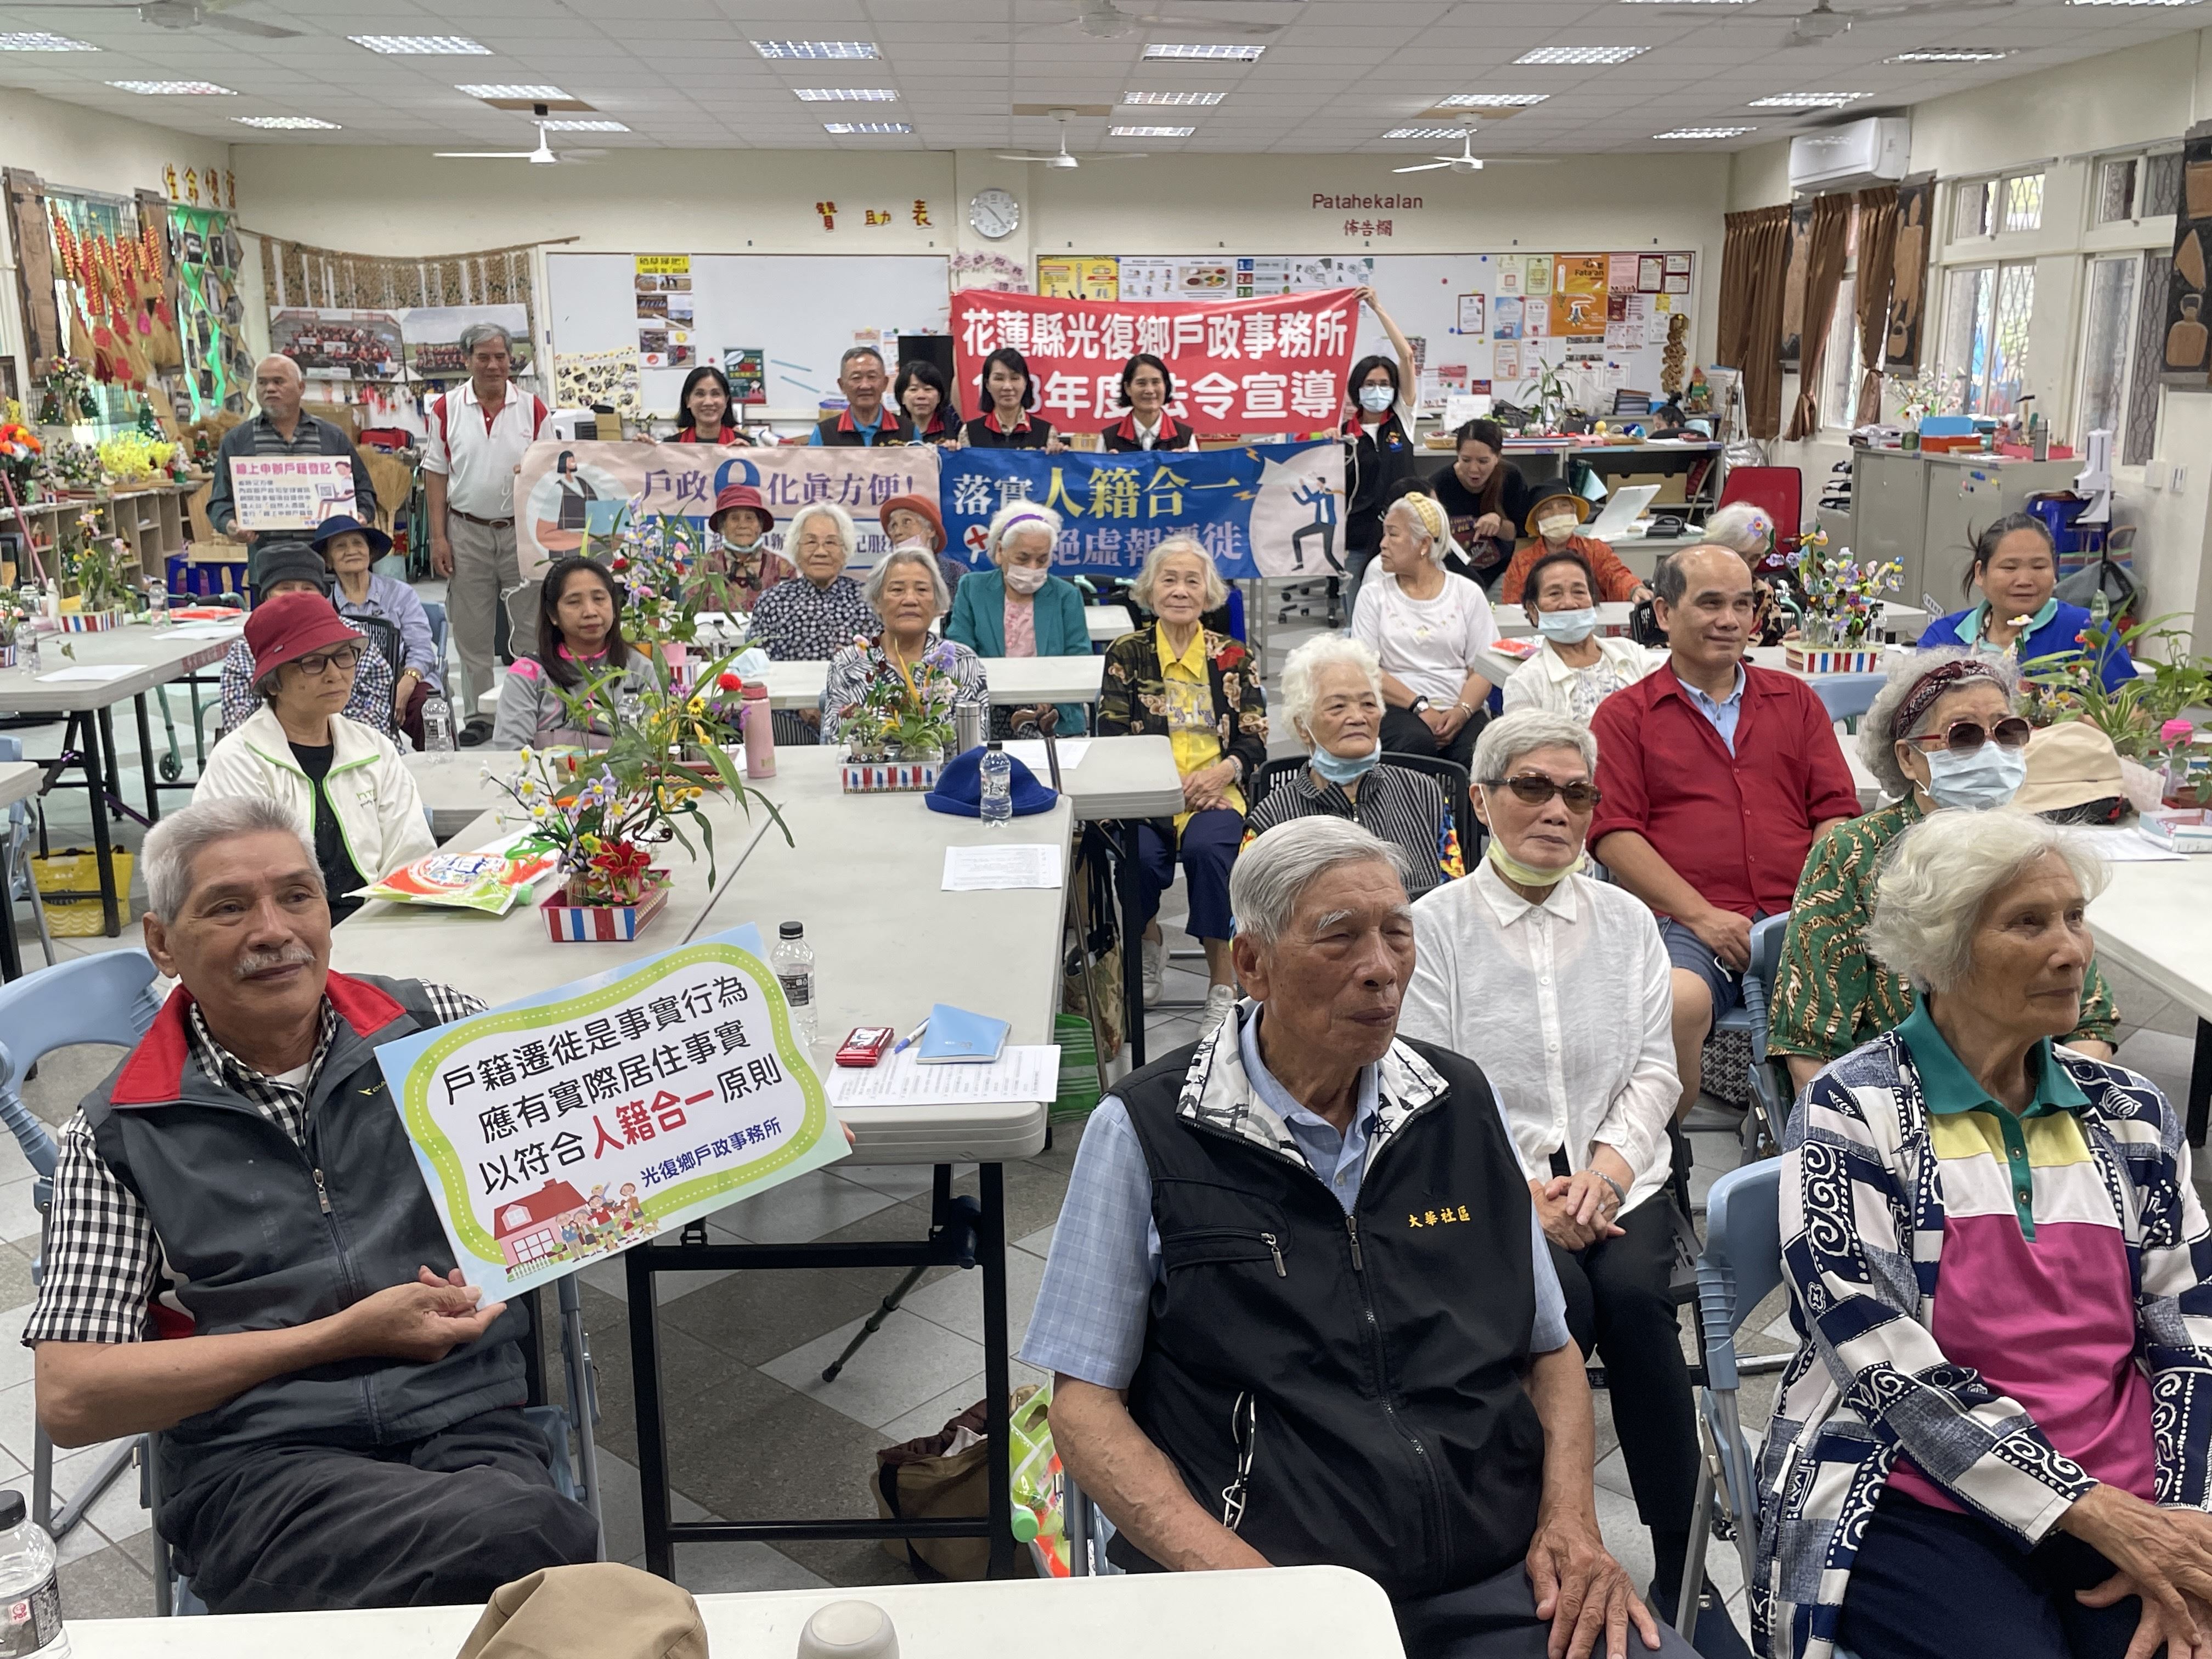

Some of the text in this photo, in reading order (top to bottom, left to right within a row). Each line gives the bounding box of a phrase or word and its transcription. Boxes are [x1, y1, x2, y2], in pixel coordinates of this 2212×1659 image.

[1312, 193, 1423, 209] Patahekalan
[961, 308, 1347, 361] 花蓮縣光復鄉戶政事務所
[443, 975, 748, 1104] 戶籍遷徙是事實行為
[479, 1019, 751, 1144] 應有實際居住事實
[479, 1053, 782, 1195] 以符合人籍合一原則
[640, 1116, 782, 1187] 光復鄉戶政事務所
[1409, 1205, 1471, 1228] 大華社區
